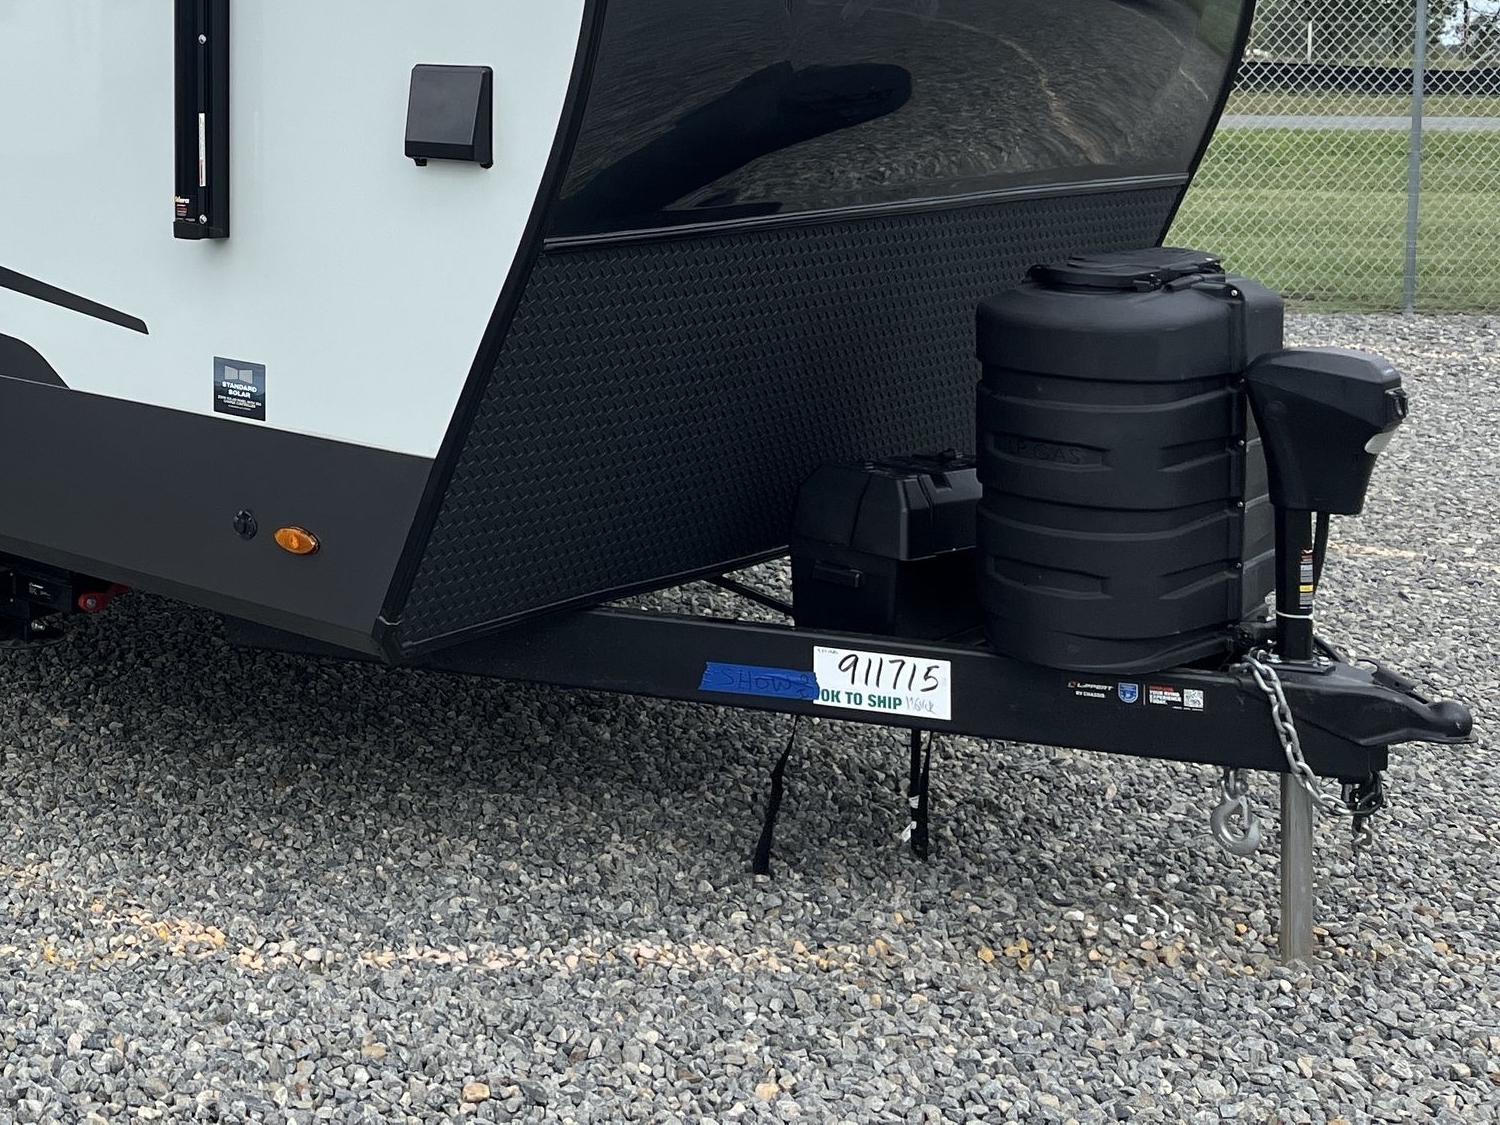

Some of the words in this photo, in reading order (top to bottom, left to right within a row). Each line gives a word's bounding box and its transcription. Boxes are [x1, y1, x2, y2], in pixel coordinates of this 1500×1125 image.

[222, 381, 258, 393] STANDARD
[228, 389, 251, 398] SOLAR
[838, 654, 940, 693] 911715
[821, 688, 841, 703] OK
[845, 691, 863, 706] TO
[867, 694, 903, 710] SHIP
